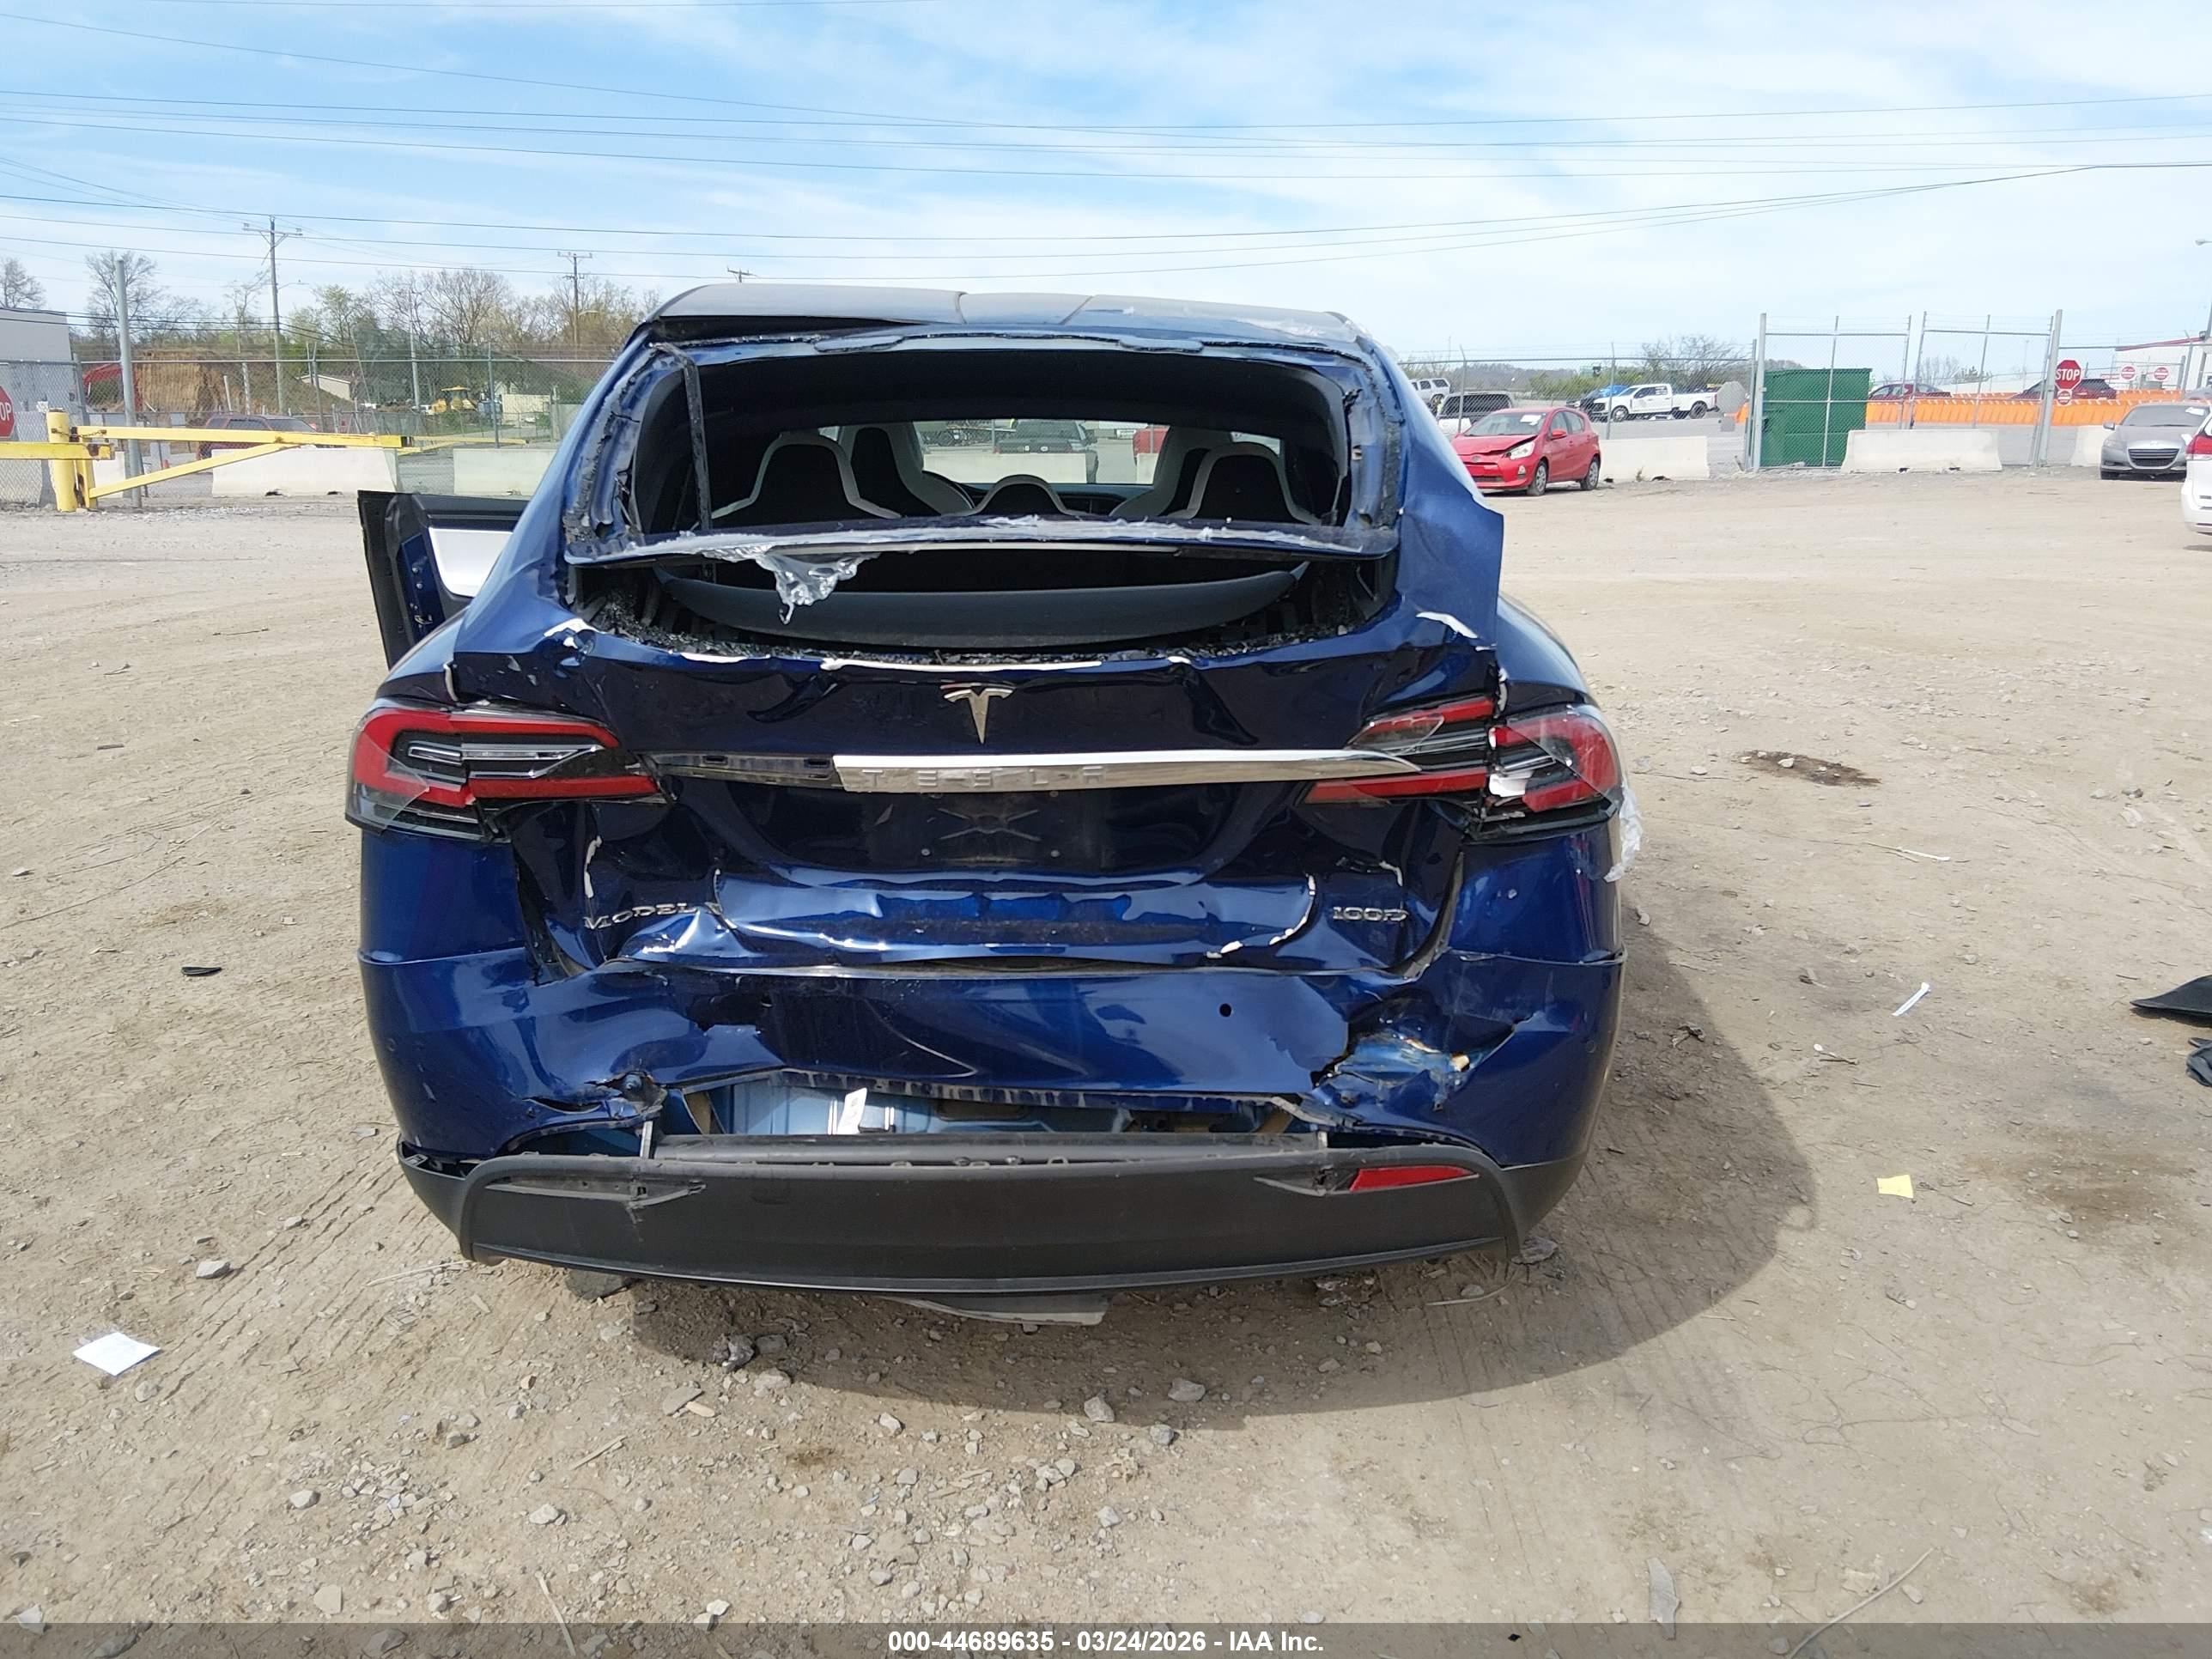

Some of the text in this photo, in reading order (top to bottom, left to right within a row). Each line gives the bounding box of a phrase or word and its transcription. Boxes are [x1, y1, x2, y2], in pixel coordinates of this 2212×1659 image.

[2056, 368, 2080, 380] STOP
[861, 766, 1103, 787] TESLA
[584, 902, 701, 929] MODEL
[1333, 907, 1408, 921] 100D
